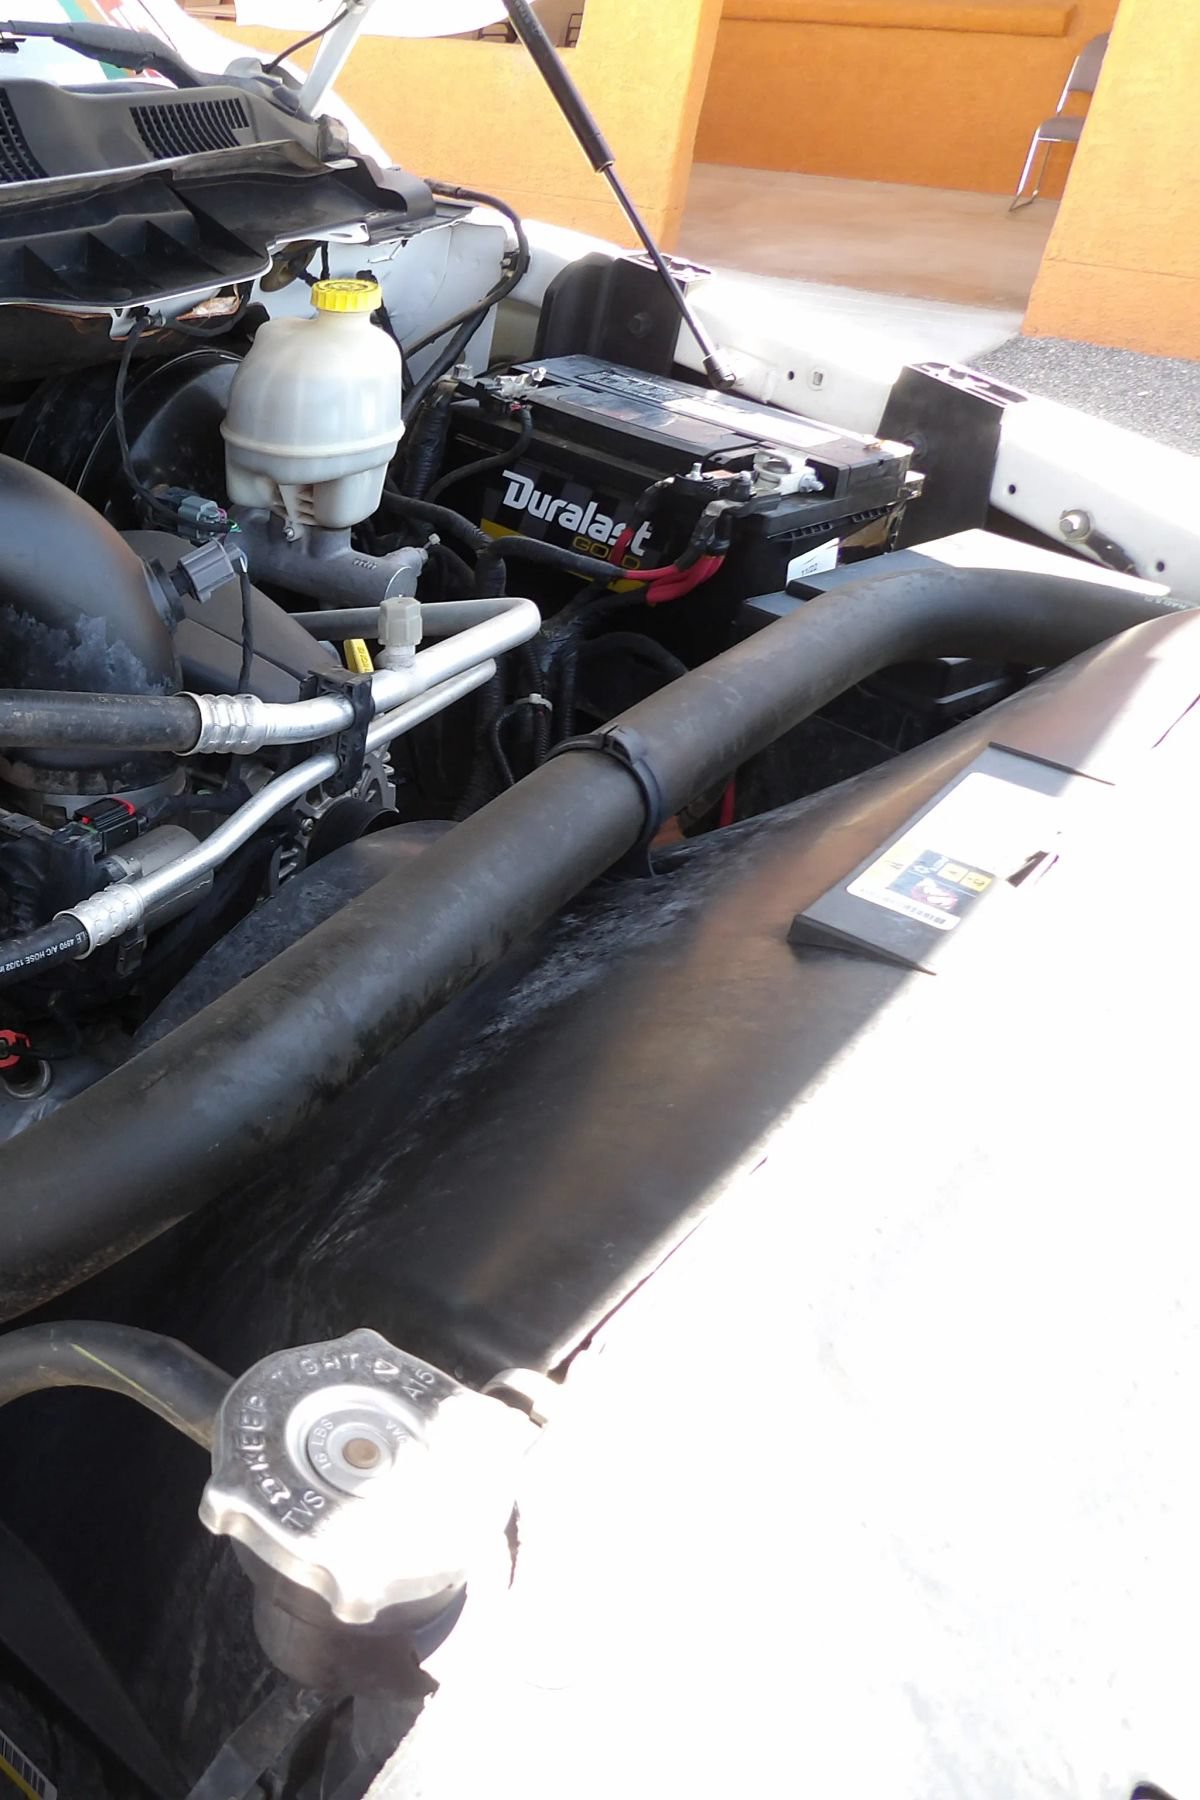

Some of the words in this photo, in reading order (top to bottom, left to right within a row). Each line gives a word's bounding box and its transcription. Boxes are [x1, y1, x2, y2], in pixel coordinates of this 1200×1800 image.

[502, 469, 653, 556] Duralast
[5, 959, 25, 971] 13/32
[25, 952, 45, 965] HOSE
[239, 1395, 270, 1471] KEEP
[311, 1418, 334, 1446] LBS
[281, 1490, 325, 1527] TVS
